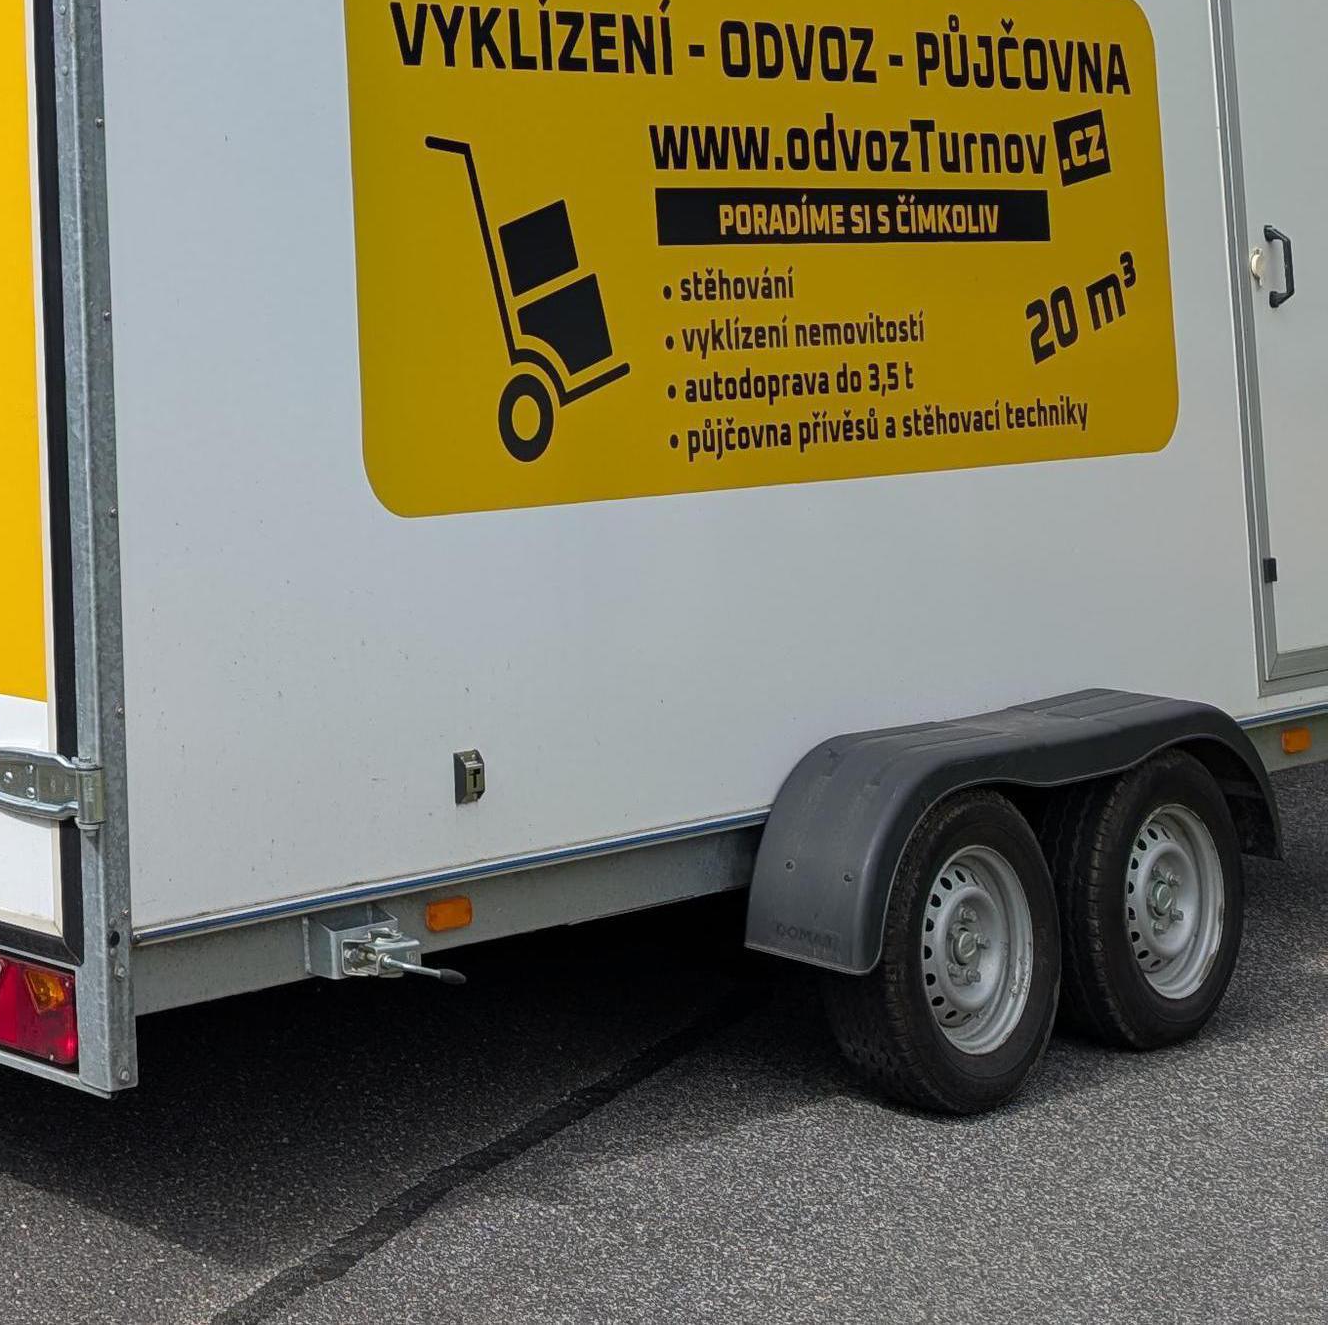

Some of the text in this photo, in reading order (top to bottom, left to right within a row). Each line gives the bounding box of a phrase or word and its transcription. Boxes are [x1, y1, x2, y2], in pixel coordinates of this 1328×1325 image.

[720, 20, 877, 83] ODVOZ
[914, 14, 1131, 95] PŮJČOVNA
[719, 195, 999, 236] PORADÍME SI S ČÍMKOLIV
[680, 266, 794, 301] stěhování
[681, 308, 925, 360] vyklízení nemovitostí
[1025, 285, 1079, 365] 20
[684, 361, 914, 405] autodoprava do 3,5 t
[687, 395, 1089, 462] půjčovna přívěsů a stěhovací techniky
